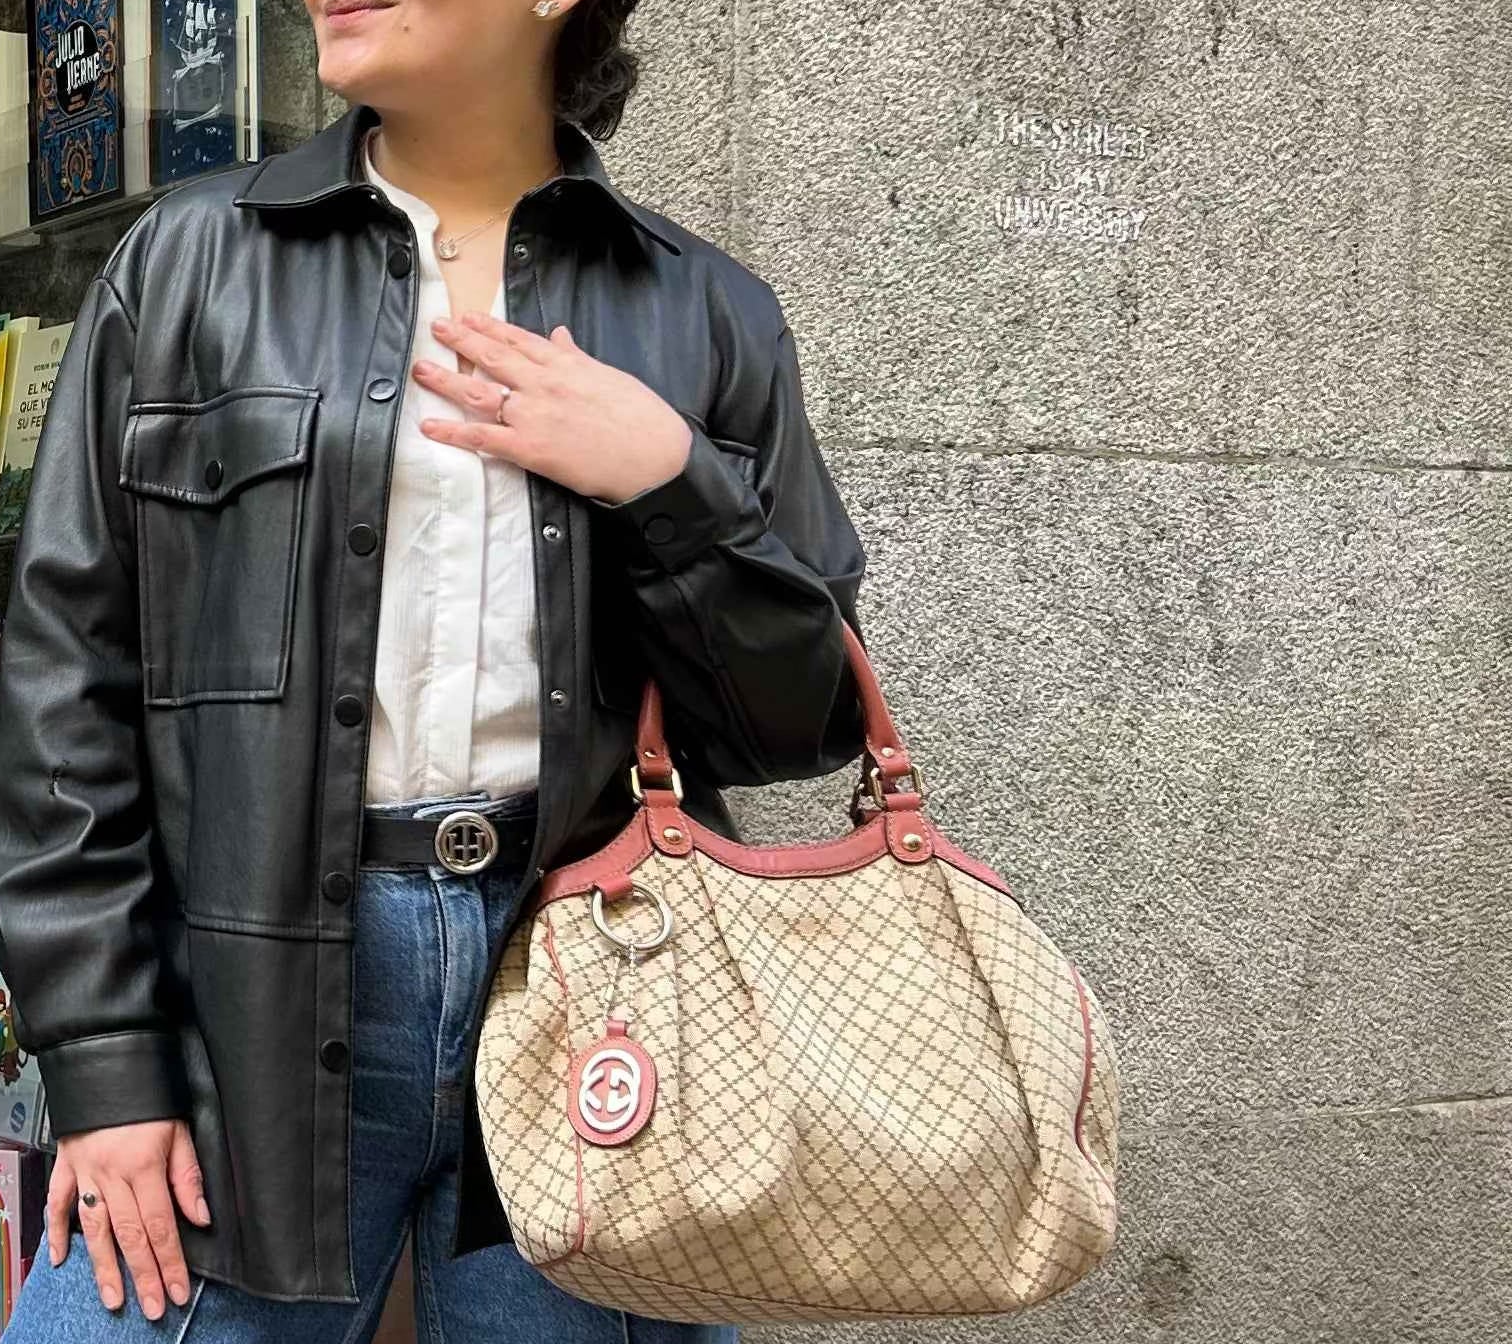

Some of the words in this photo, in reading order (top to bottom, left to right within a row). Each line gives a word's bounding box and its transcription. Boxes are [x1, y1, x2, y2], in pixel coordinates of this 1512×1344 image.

[55, 25, 86, 69] JULIO
[66, 51, 102, 96] VERNE
[27, 383, 39, 395] EL
[20, 399, 38, 413] QUE
[17, 418, 28, 430] SU
